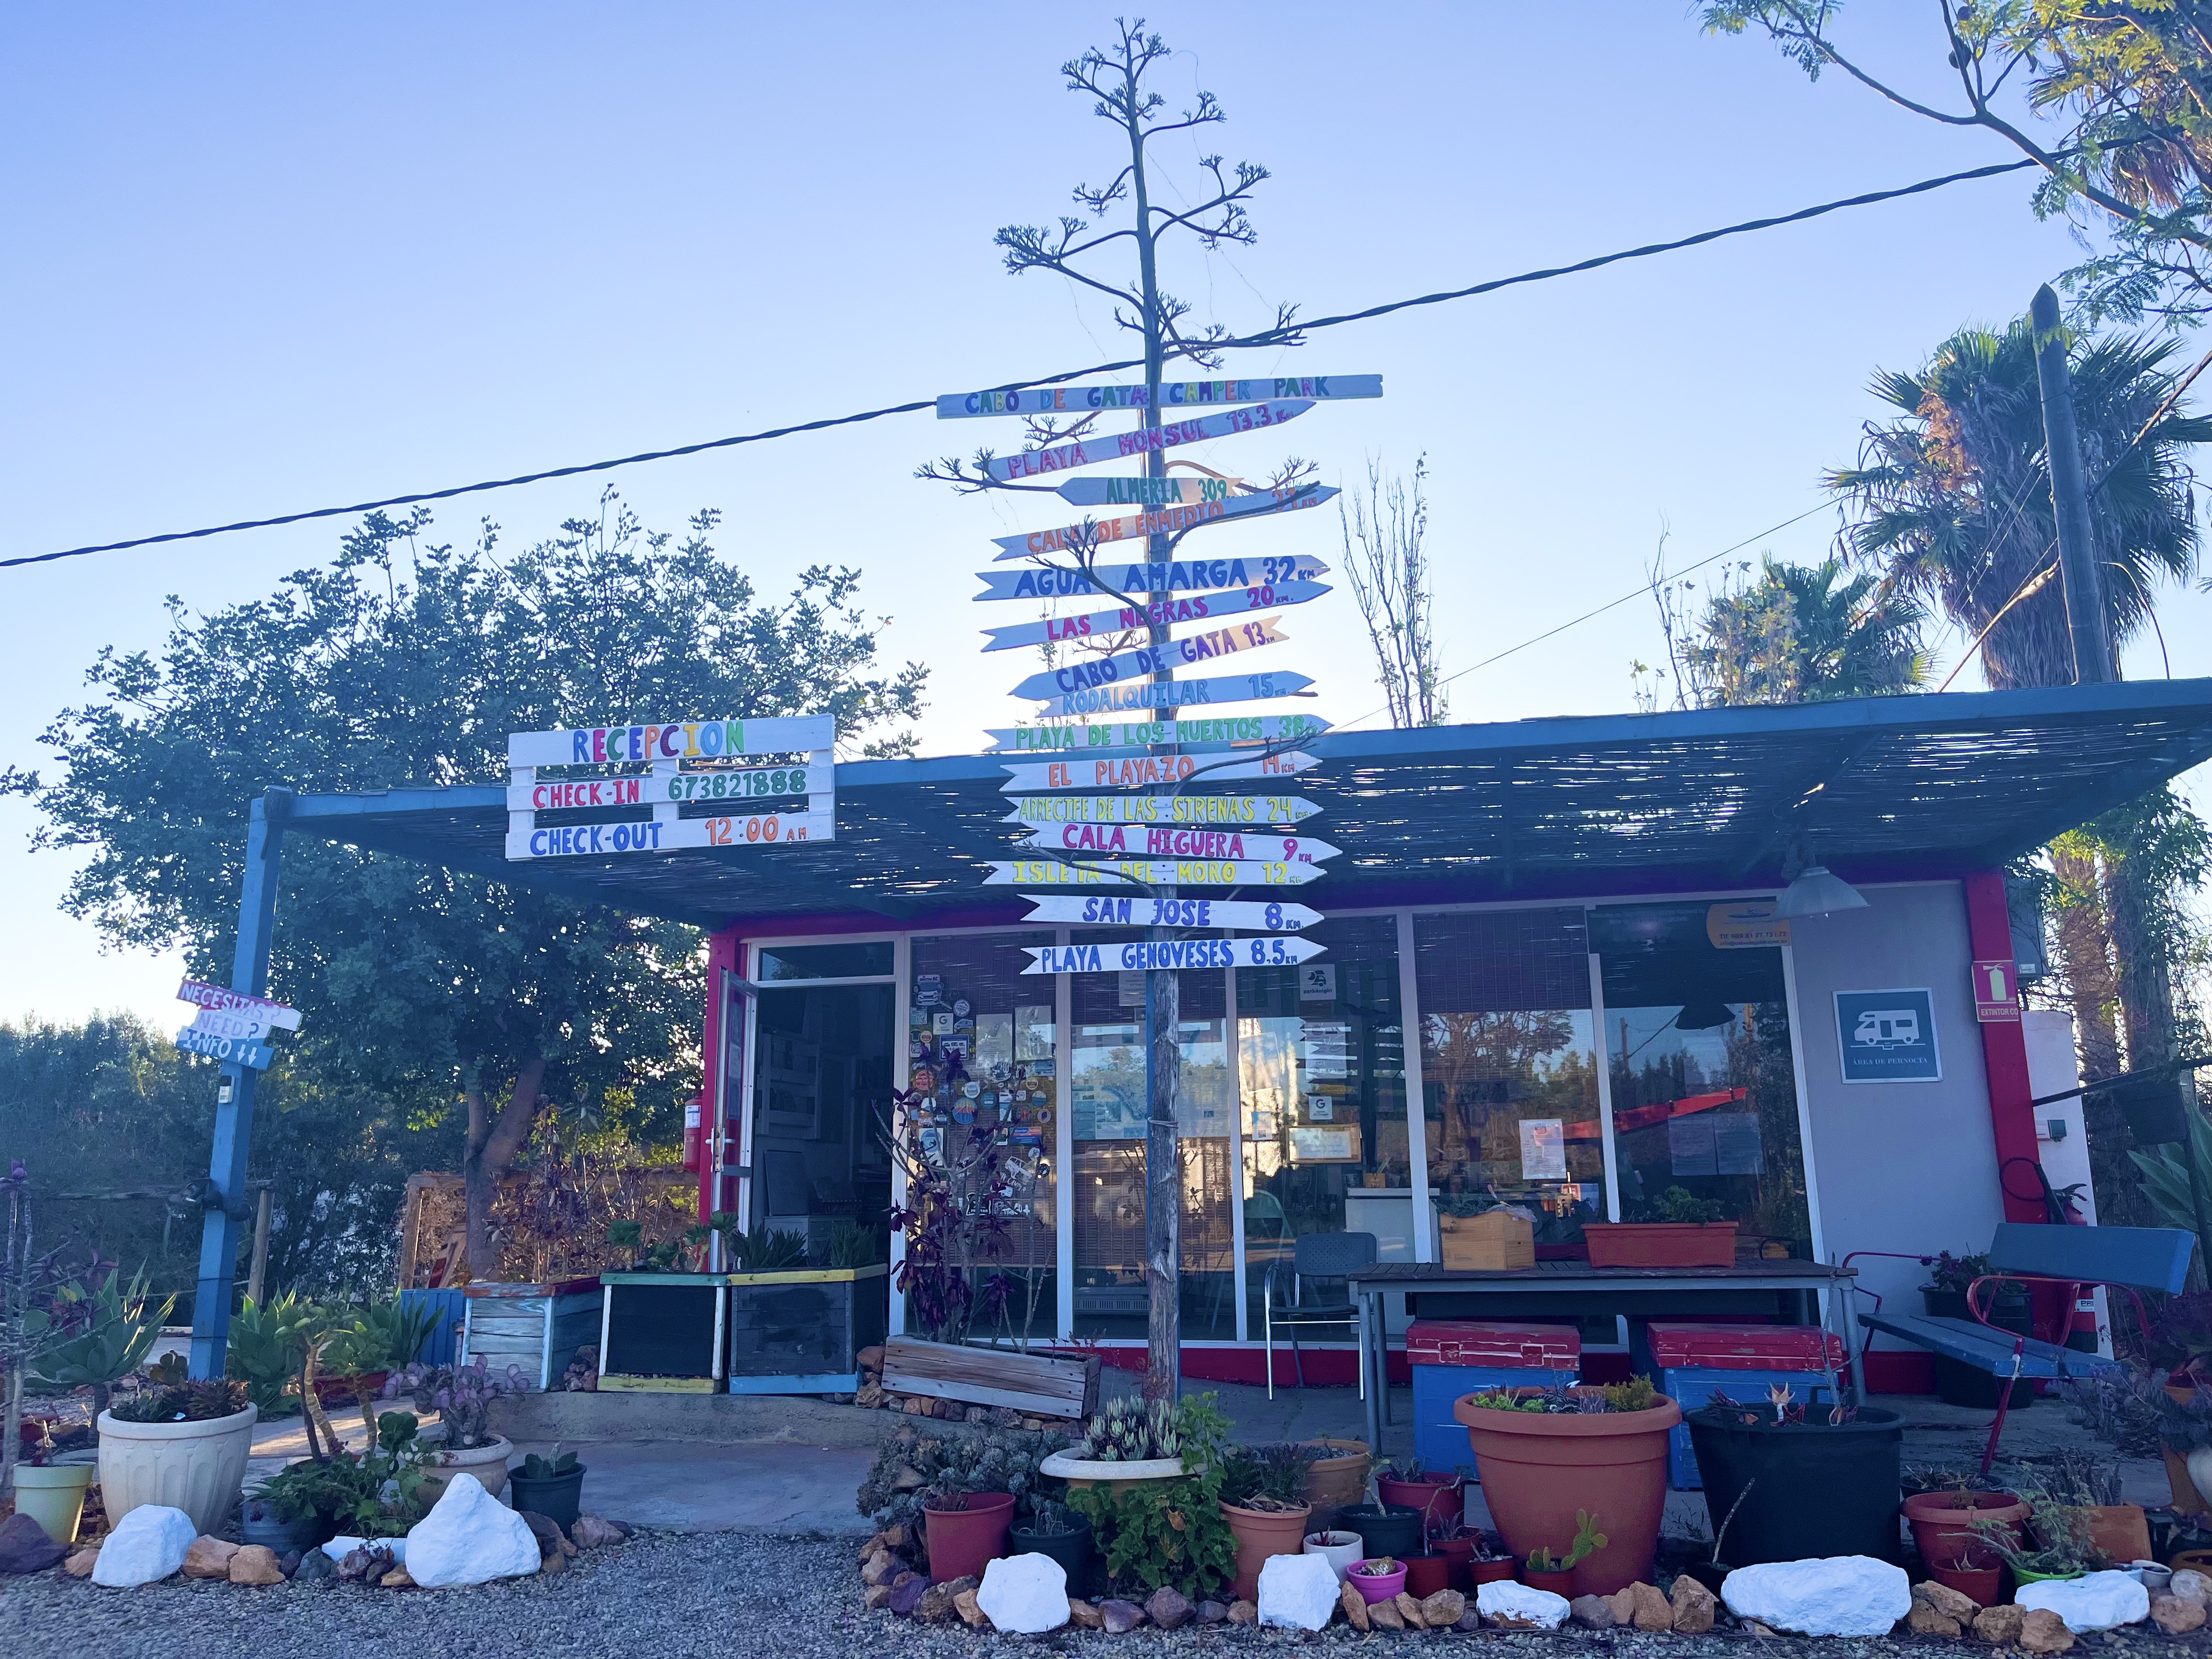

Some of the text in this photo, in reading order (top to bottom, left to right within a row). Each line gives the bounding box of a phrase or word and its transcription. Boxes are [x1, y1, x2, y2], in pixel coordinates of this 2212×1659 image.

[966, 376, 1330, 414] CABO DE GATA CAMPER PARK
[1007, 443, 1088, 479] PLAYA
[1119, 419, 1210, 456] MONSUL
[1107, 478, 1227, 503] ALMERIA 309
[1028, 525, 1082, 553] CALA
[1097, 518, 1122, 543] DE
[1136, 501, 1224, 535] ENMEDIO
[1014, 568, 1091, 597] AGUA
[1124, 558, 1249, 592] AMARGA
[1263, 556, 1296, 584] 32
[1047, 615, 1091, 640] LAS
[1120, 596, 1208, 629] NEGRAS
[1246, 586, 1274, 607] 20
[1056, 658, 1118, 692] CABO
[1136, 646, 1166, 674] DE
[1180, 628, 1237, 662] GATA
[1243, 622, 1266, 647] 13
[1063, 680, 1210, 714] RODALQUILAR
[1248, 674, 1273, 698] 15
[574, 720, 744, 763] RECEPCION
[1016, 725, 1075, 748] PLAYA
[1088, 723, 1113, 746] DE
[1124, 721, 1164, 744] LOS
[1176, 717, 1263, 742] MUERTOS
[1279, 715, 1305, 738] 38
[1049, 763, 1072, 787] EL
[1096, 755, 1195, 785] PLAYAZO
[1263, 754, 1280, 774] 14
[533, 770, 806, 809] CHECK-IN 673821888
[1019, 797, 1089, 822] ARRECIFE
[1097, 797, 1115, 820] DE
[1124, 797, 1156, 820] LAS
[1172, 797, 1255, 822] SIRENAS
[1267, 798, 1292, 822] 24
[530, 822, 663, 856] CHECK-OUT
[705, 816, 779, 846] 12:00
[1063, 825, 1126, 851] CALA
[1148, 829, 1245, 858] HIGUERA
[1283, 838, 1299, 862] 9
[1013, 861, 1101, 883] ISLETA
[1121, 861, 1156, 883] DEL
[1177, 861, 1237, 884] MORO
[1262, 862, 1287, 884] 12
[1082, 897, 1132, 925] SAN
[1152, 899, 1211, 927] JOSE
[1265, 902, 1283, 931] 8
[1042, 946, 1102, 973] PLAYA
[1122, 940, 1234, 970] GENOVESES
[1250, 939, 1285, 965] 8,5
[180, 983, 266, 1020] NECESITAS
[1980, 1008, 2009, 1016] EXTINTOR
[183, 1029, 233, 1058] INFO
[198, 1012, 259, 1042] NEED ?
[1852, 1057, 1873, 1066] ÁREA
[1316, 1098, 1326, 1109] G
